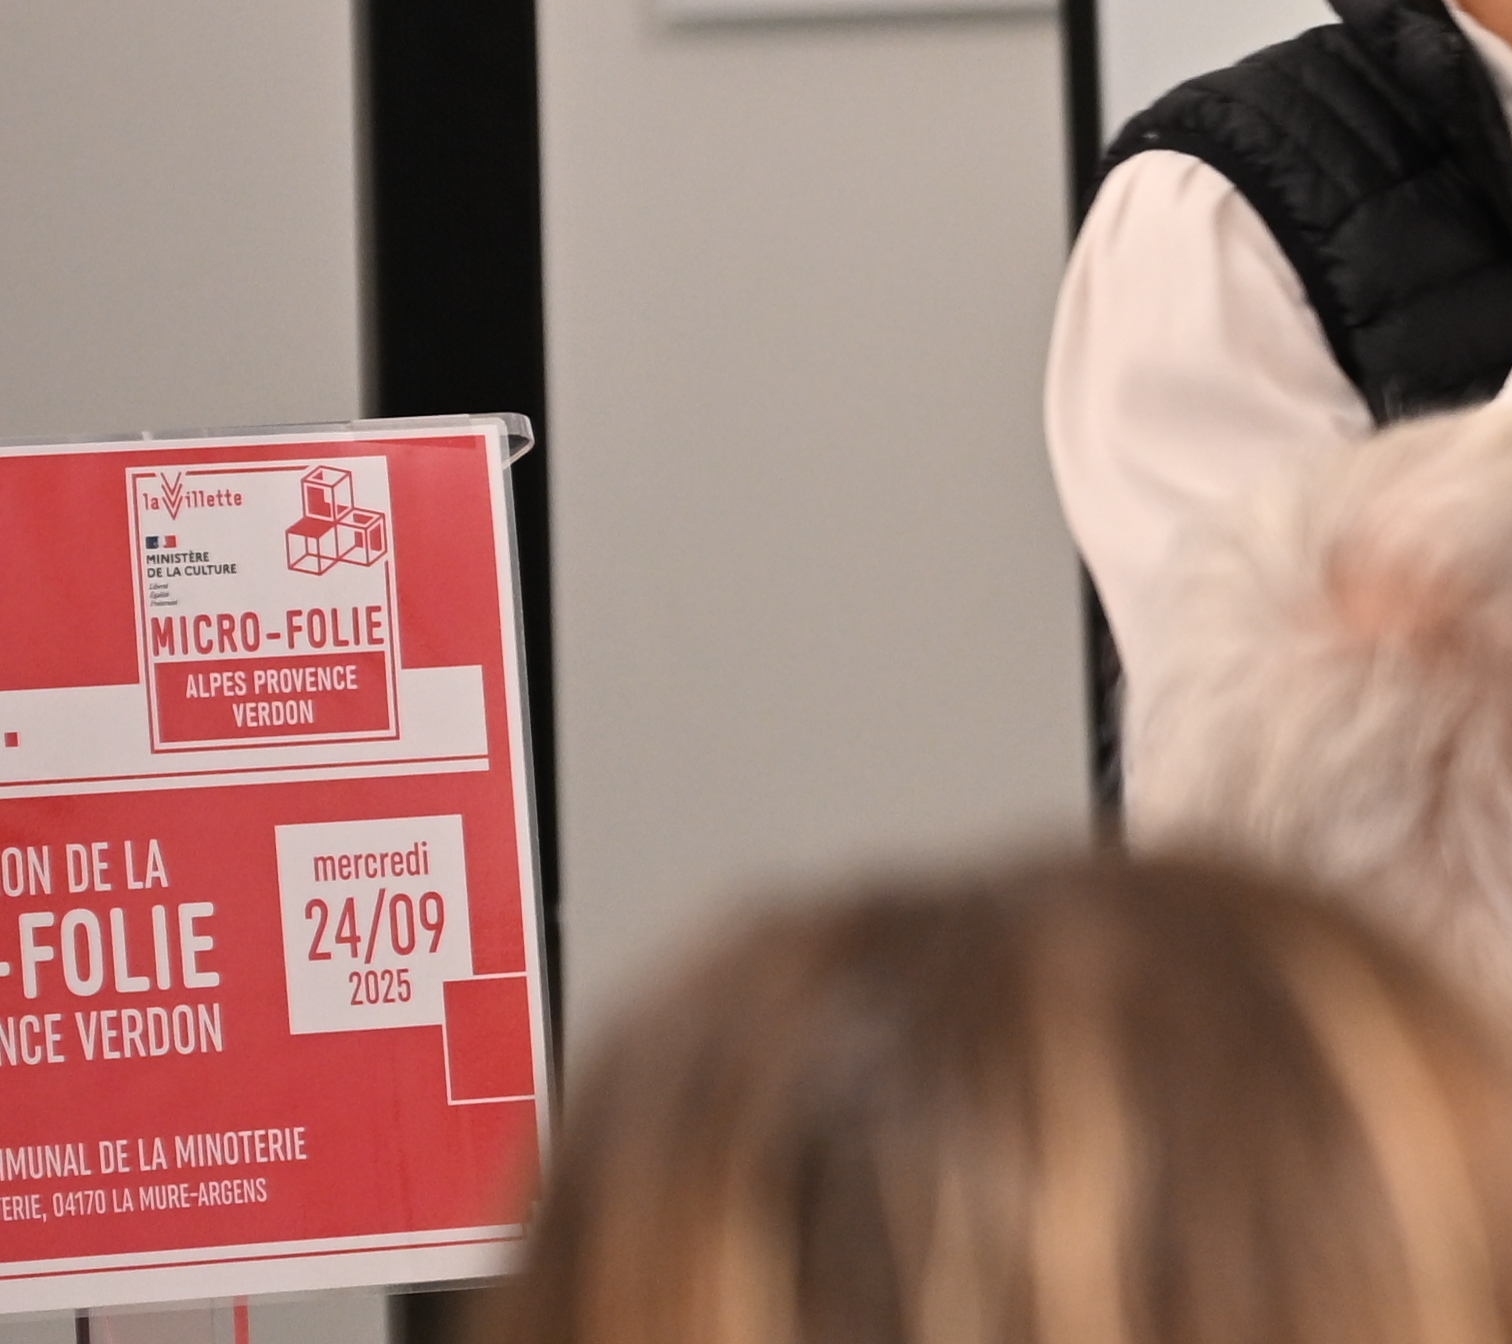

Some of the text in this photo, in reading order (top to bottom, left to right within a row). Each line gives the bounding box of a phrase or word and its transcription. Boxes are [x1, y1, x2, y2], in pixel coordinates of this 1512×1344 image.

[146, 550, 210, 565] MINISTÈRE
[147, 563, 238, 578] DE LA CULTURE
[186, 664, 358, 699] ALPES PROVENCE
[232, 699, 315, 728] VERDON
[65, 841, 112, 894] DE
[124, 838, 169, 890] LA
[313, 841, 430, 883] mercredi
[304, 887, 446, 965] 24/09
[348, 968, 412, 1006] 2025
[75, 1002, 224, 1062] VERDON
[0, 1126, 308, 1182] MUNAL DE LA MINOTERIE
[0, 1177, 268, 1223] ERIE, 04170 LA MURE-ARGENS
